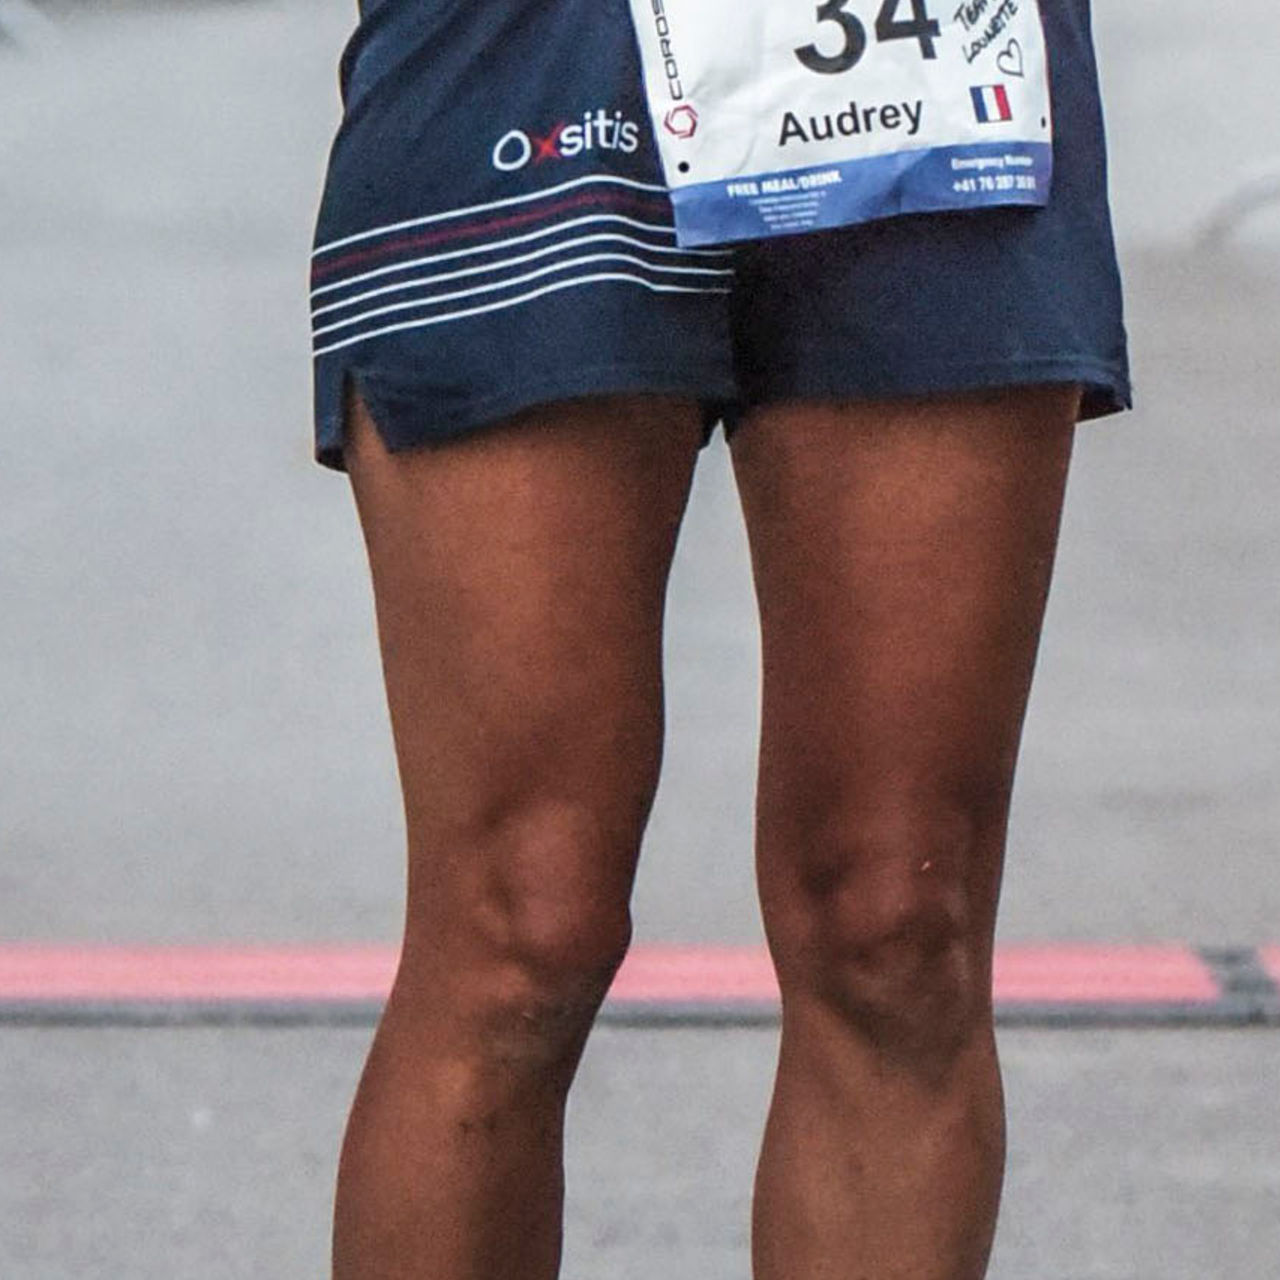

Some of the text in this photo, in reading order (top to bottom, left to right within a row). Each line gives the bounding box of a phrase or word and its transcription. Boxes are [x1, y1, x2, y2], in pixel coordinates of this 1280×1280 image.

[492, 109, 640, 171] Oxsitis
[778, 99, 923, 147] Audrey
[726, 181, 760, 198] FREE
